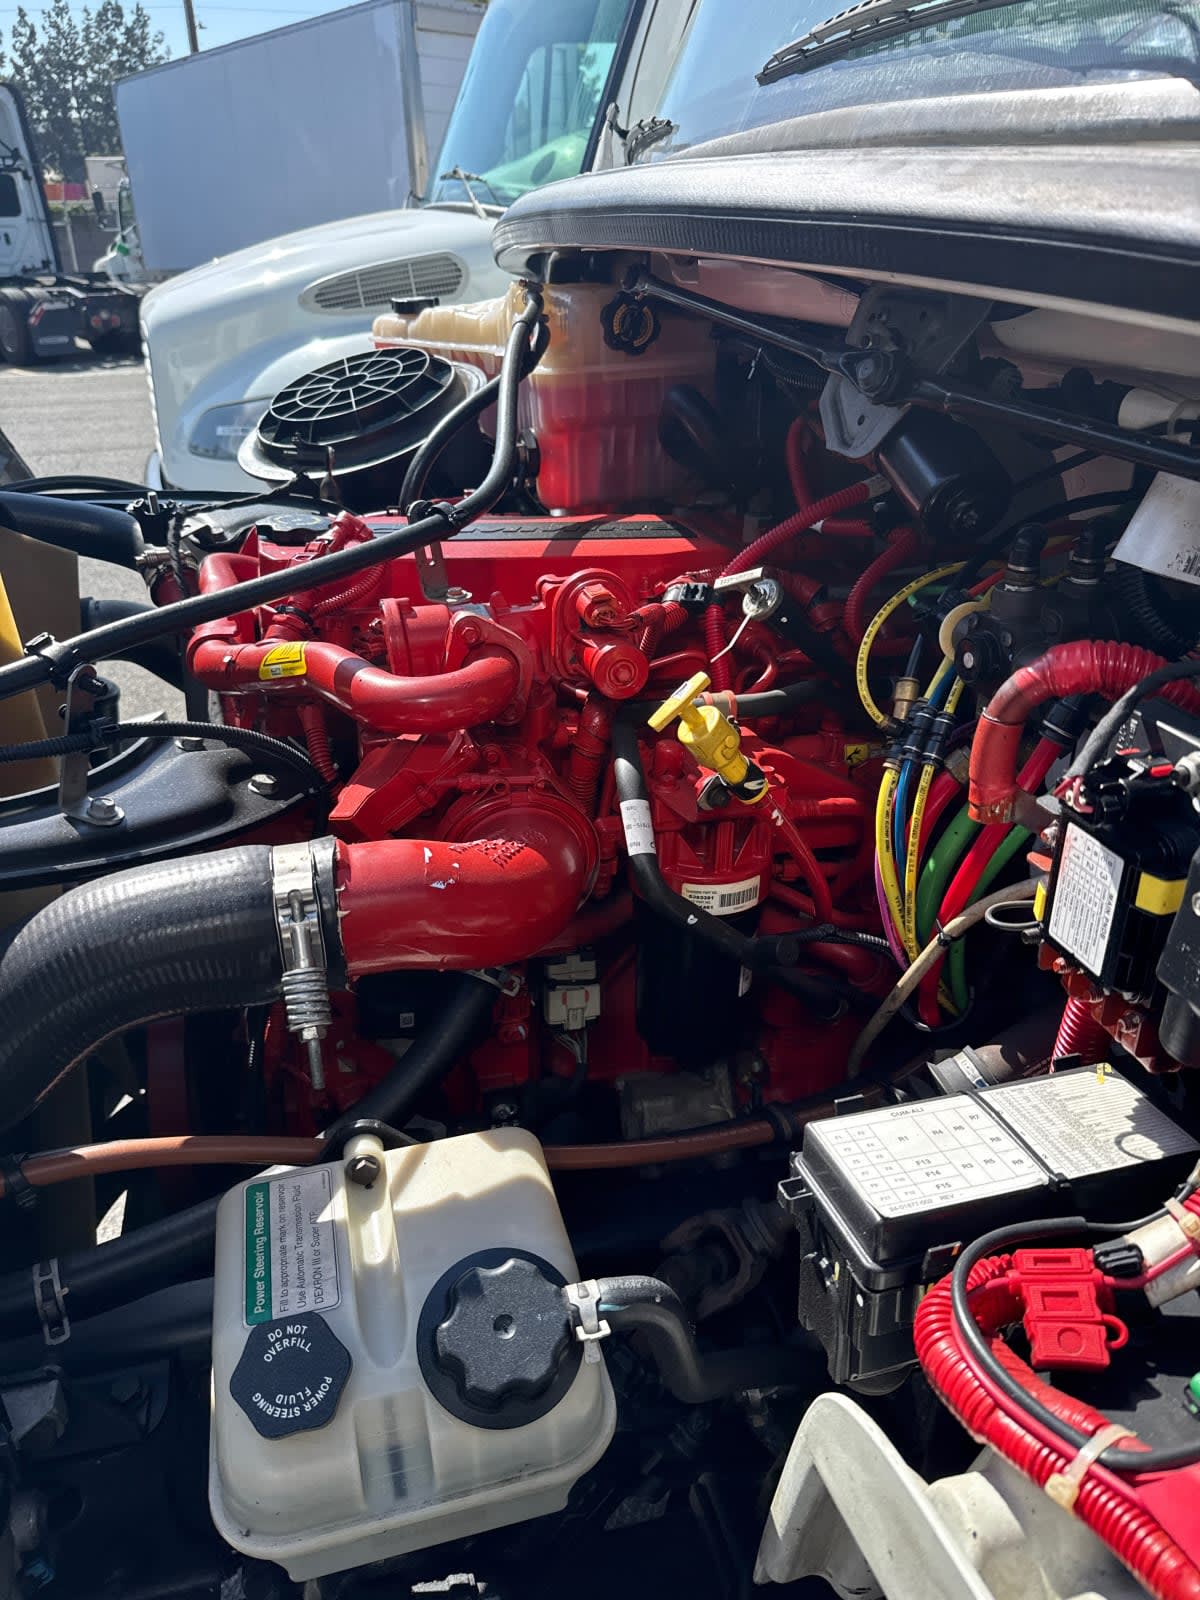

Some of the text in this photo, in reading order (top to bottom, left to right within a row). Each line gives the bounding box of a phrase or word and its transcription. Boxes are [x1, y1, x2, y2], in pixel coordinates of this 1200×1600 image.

[1085, 860, 1094, 871] 2
[1100, 871, 1108, 881] 3
[278, 1183, 286, 1212] reservoir
[280, 1214, 286, 1223] on
[293, 1185, 307, 1308] Use Automatic Transmission Fluid
[311, 1226, 322, 1247] Super
[254, 1191, 267, 1313] Power Steering Reservoir
[279, 1245, 290, 1287] appropriate
[280, 1289, 288, 1298] to
[313, 1267, 324, 1304] DEXRON
[279, 1298, 289, 1313] Fill
[267, 1324, 308, 1342] DO NOT
[263, 1337, 312, 1362] OVERFILL
[252, 1376, 333, 1418] POWER STEERING
[275, 1387, 312, 1405] FLUID
